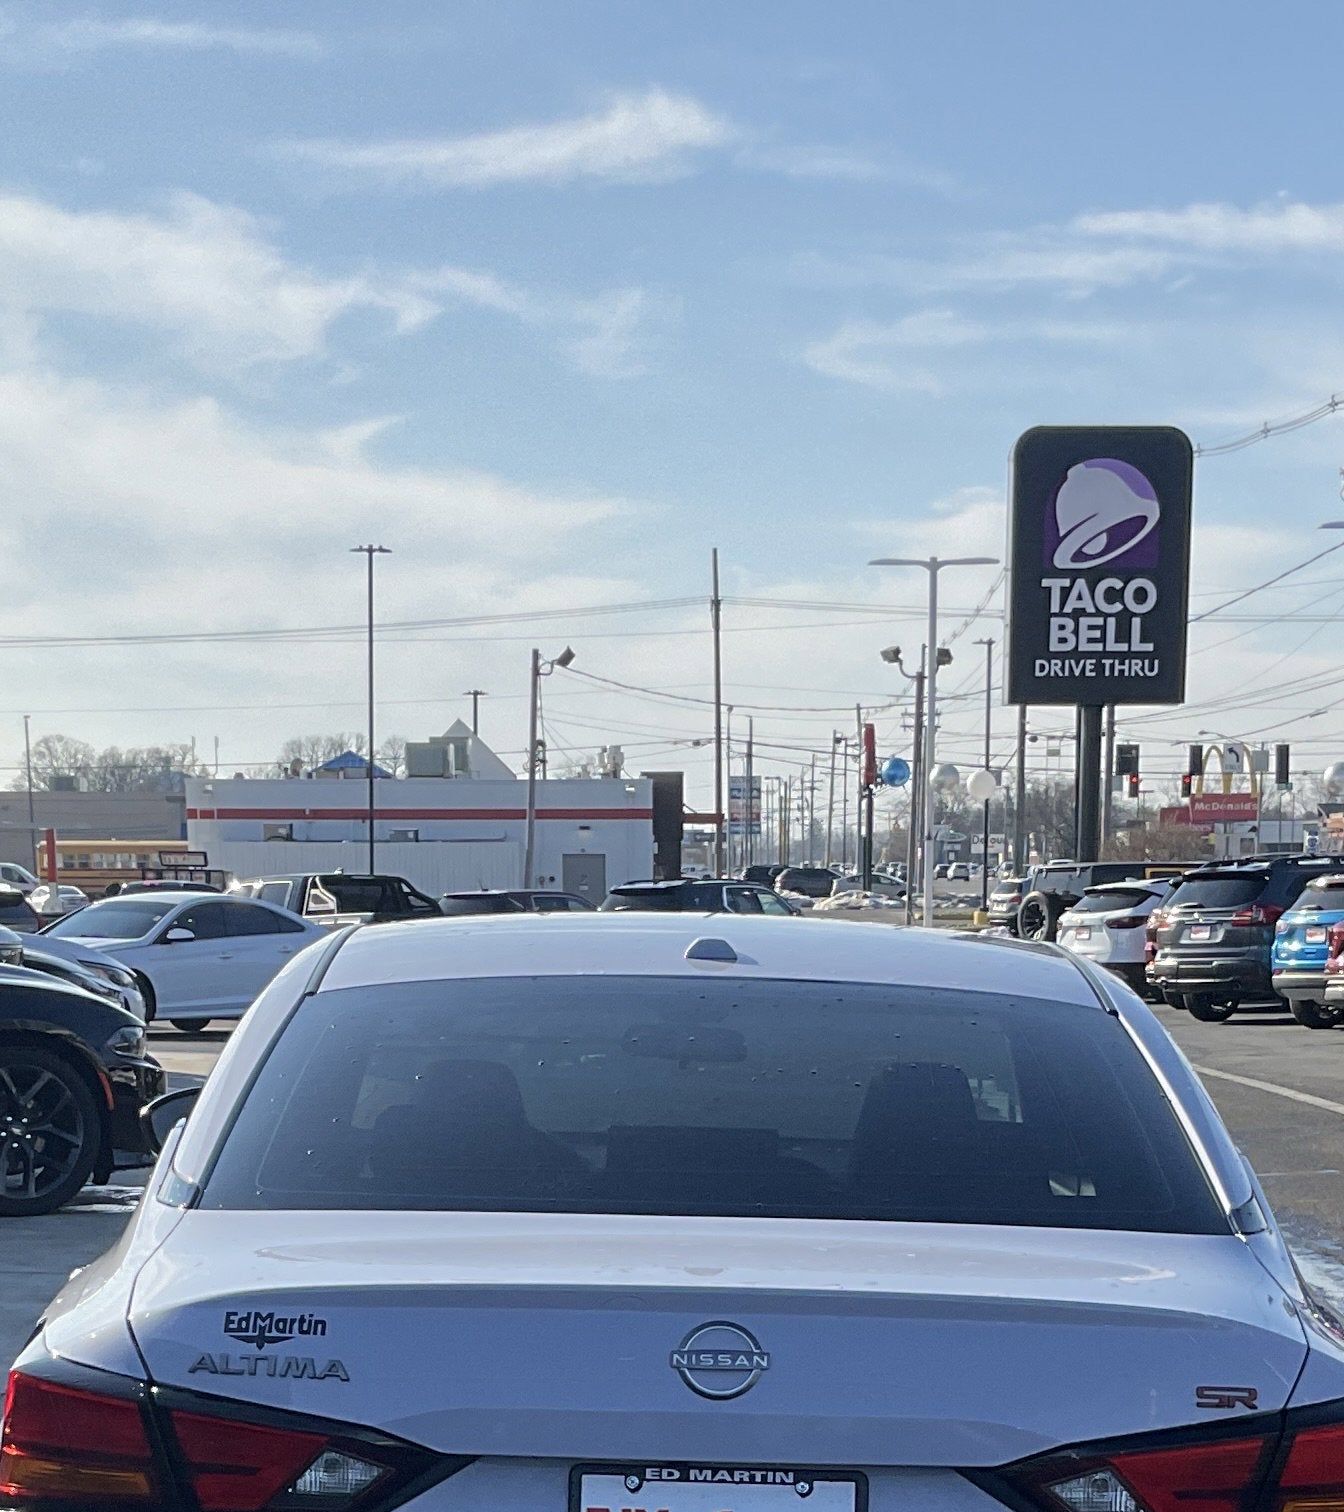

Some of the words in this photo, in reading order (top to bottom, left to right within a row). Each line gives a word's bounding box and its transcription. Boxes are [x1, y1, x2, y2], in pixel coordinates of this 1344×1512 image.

[1041, 577, 1157, 614] TACO
[1048, 616, 1154, 652] BELL
[1034, 658, 1096, 677] DRIVE
[1101, 658, 1159, 677] THRU
[1194, 802, 1257, 811] McDonald's
[188, 1352, 350, 1382] ALTIMA
[671, 1352, 768, 1369] NISSAN
[1196, 1386, 1258, 1409] SR
[645, 1468, 681, 1480] ED
[689, 1469, 794, 1484] MARTIN
